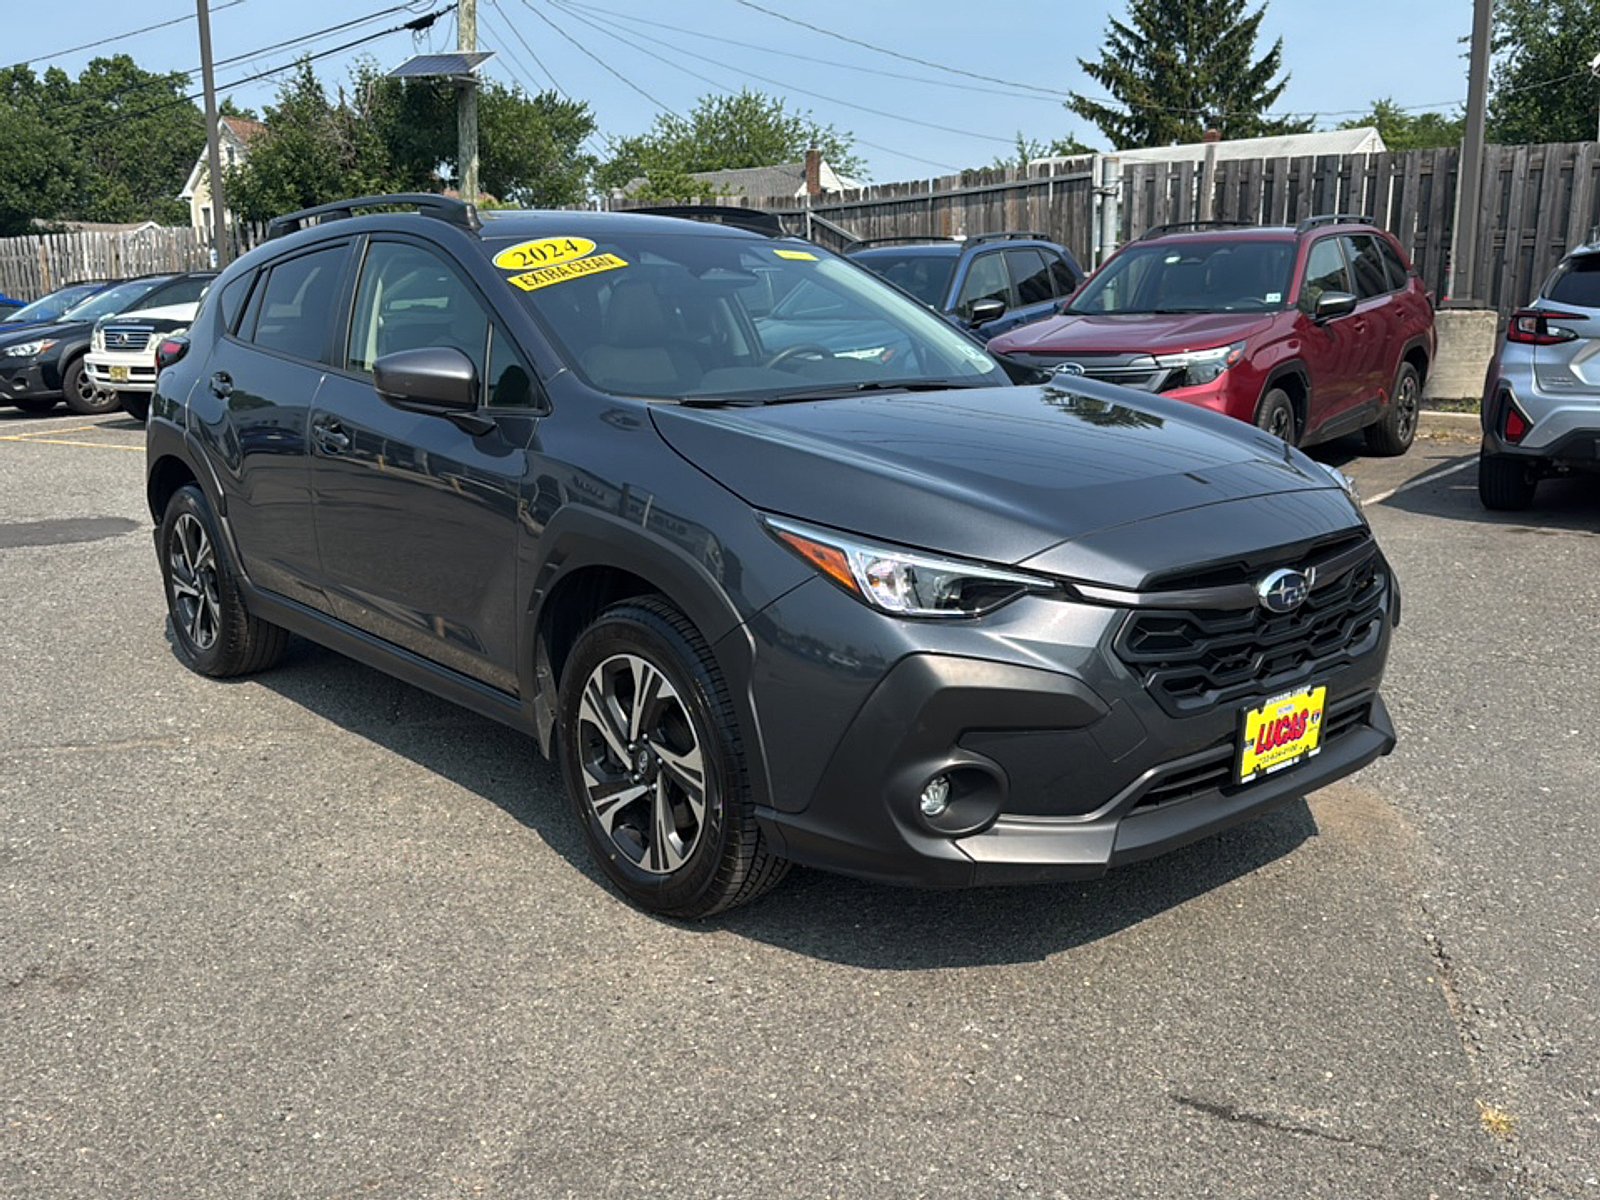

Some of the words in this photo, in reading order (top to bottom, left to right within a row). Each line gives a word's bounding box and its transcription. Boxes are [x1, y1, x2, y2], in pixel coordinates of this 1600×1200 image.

[513, 239, 578, 266] 2024
[519, 265, 569, 286] EXTRA
[567, 256, 615, 274] CLEAN
[1256, 709, 1308, 755] LUCAS
